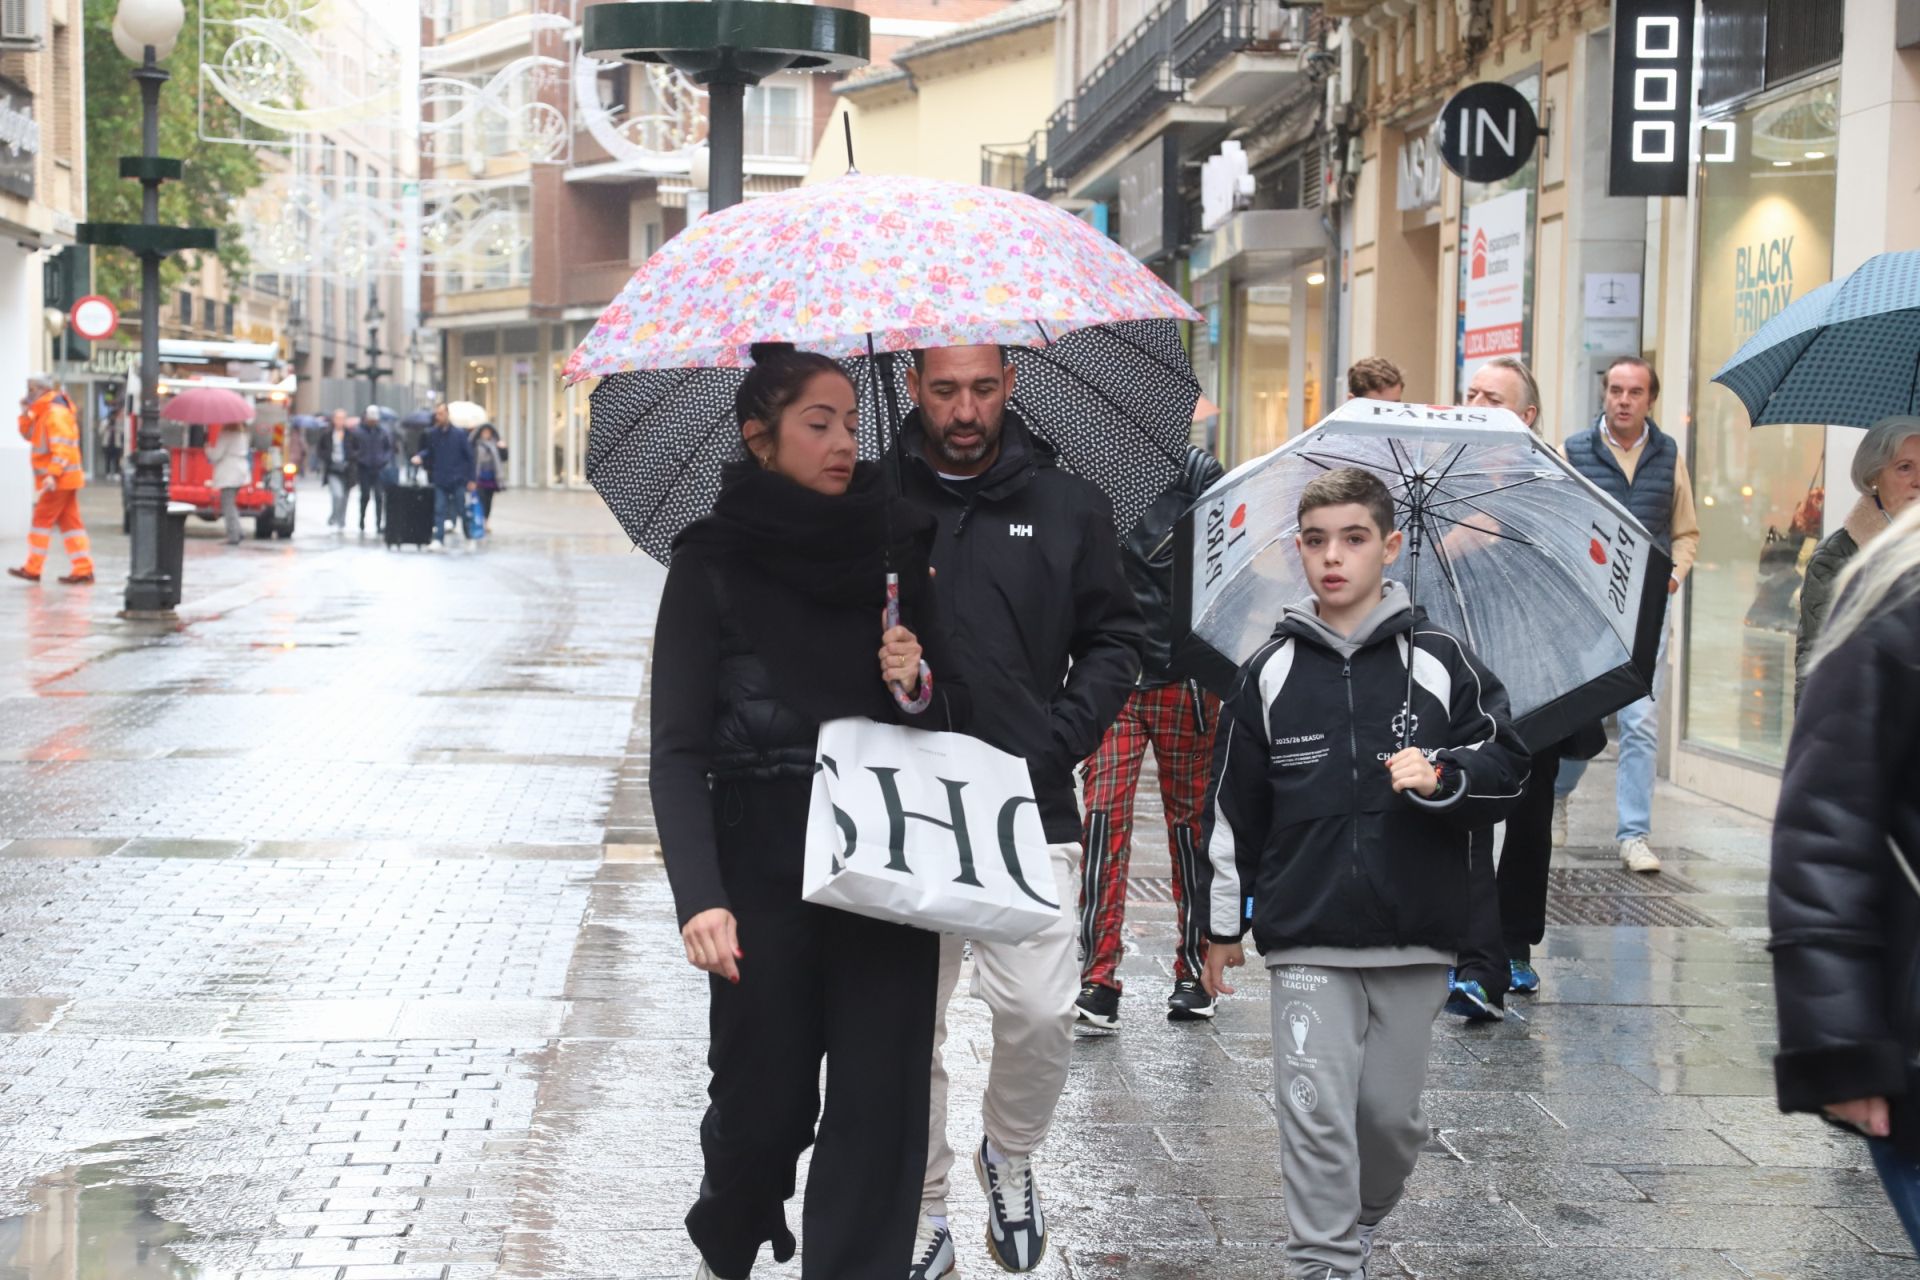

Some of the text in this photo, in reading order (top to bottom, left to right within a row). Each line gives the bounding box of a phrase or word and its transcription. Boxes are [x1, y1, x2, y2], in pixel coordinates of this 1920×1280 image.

[1459, 108, 1517, 157] IN
[1735, 235, 1794, 291] BLACK
[1733, 283, 1793, 334] FRIDAY
[1373, 406, 1488, 423] PARIS
[1009, 523, 1033, 537] HH
[1300, 733, 1325, 743] SEASON
[1281, 979, 1317, 991] LEAGUE
